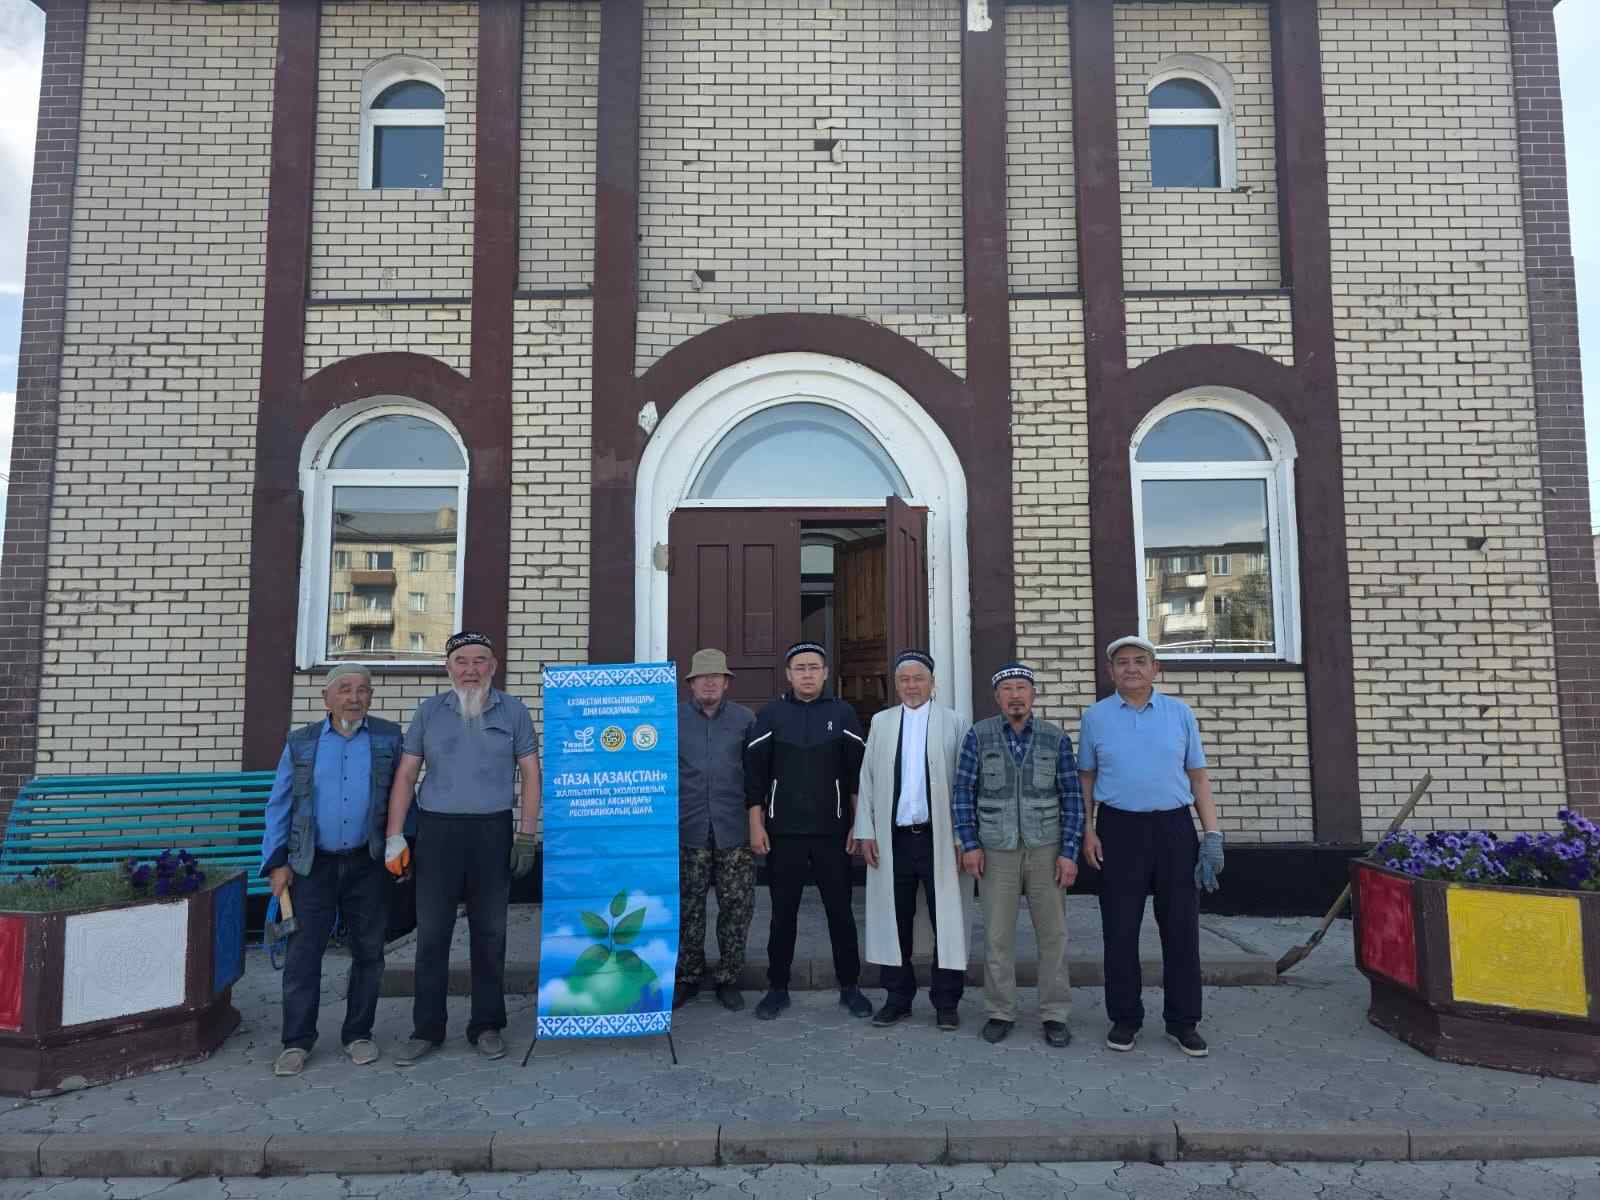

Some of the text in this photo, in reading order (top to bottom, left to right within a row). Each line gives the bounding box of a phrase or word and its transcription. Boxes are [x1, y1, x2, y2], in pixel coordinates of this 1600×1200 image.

[553, 769, 668, 786] «ТАЗА ҚАЗАҚСТАН»
[632, 805, 653, 815] ШАРА
